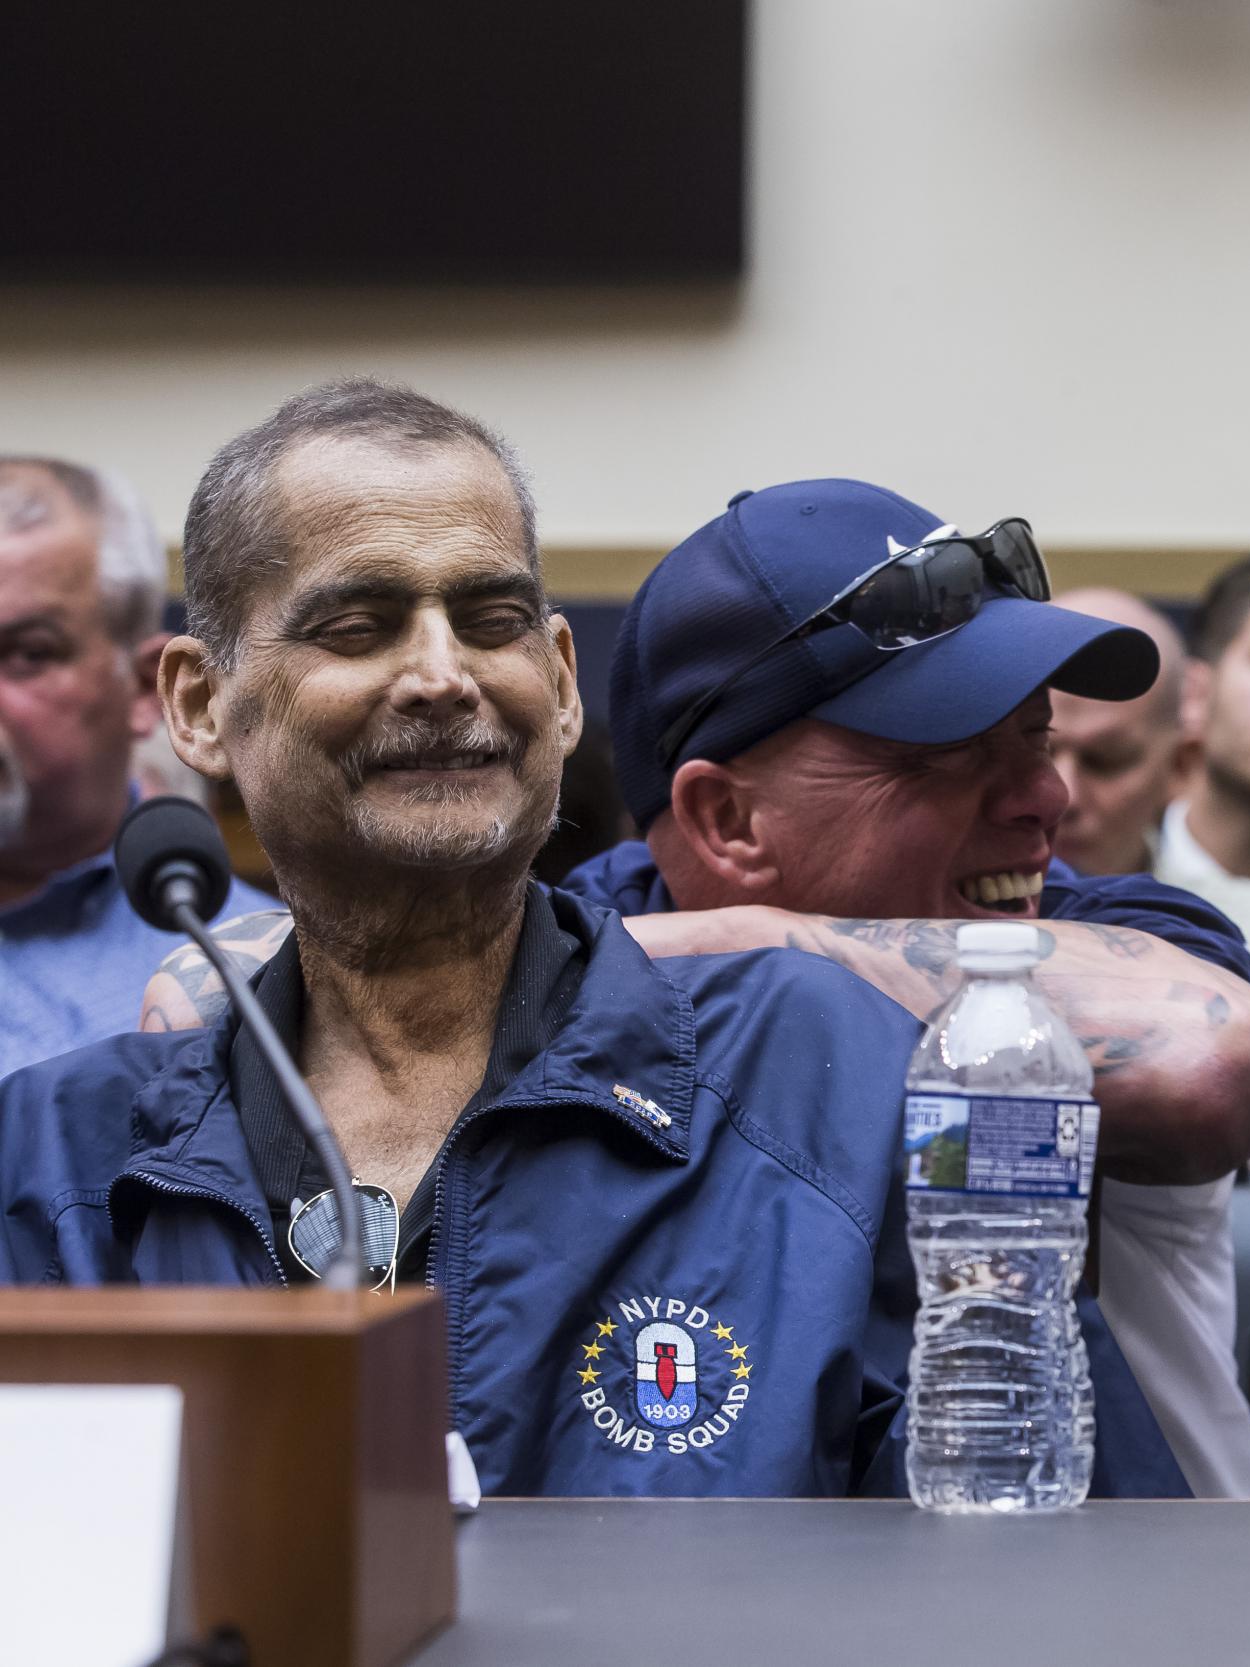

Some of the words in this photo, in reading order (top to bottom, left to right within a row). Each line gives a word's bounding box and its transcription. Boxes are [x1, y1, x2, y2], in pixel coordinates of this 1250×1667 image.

[619, 1297, 709, 1328] NYPD
[581, 1388, 655, 1452] BOMB
[668, 1384, 749, 1454] SQUAD
[644, 1405, 691, 1419] 1903
